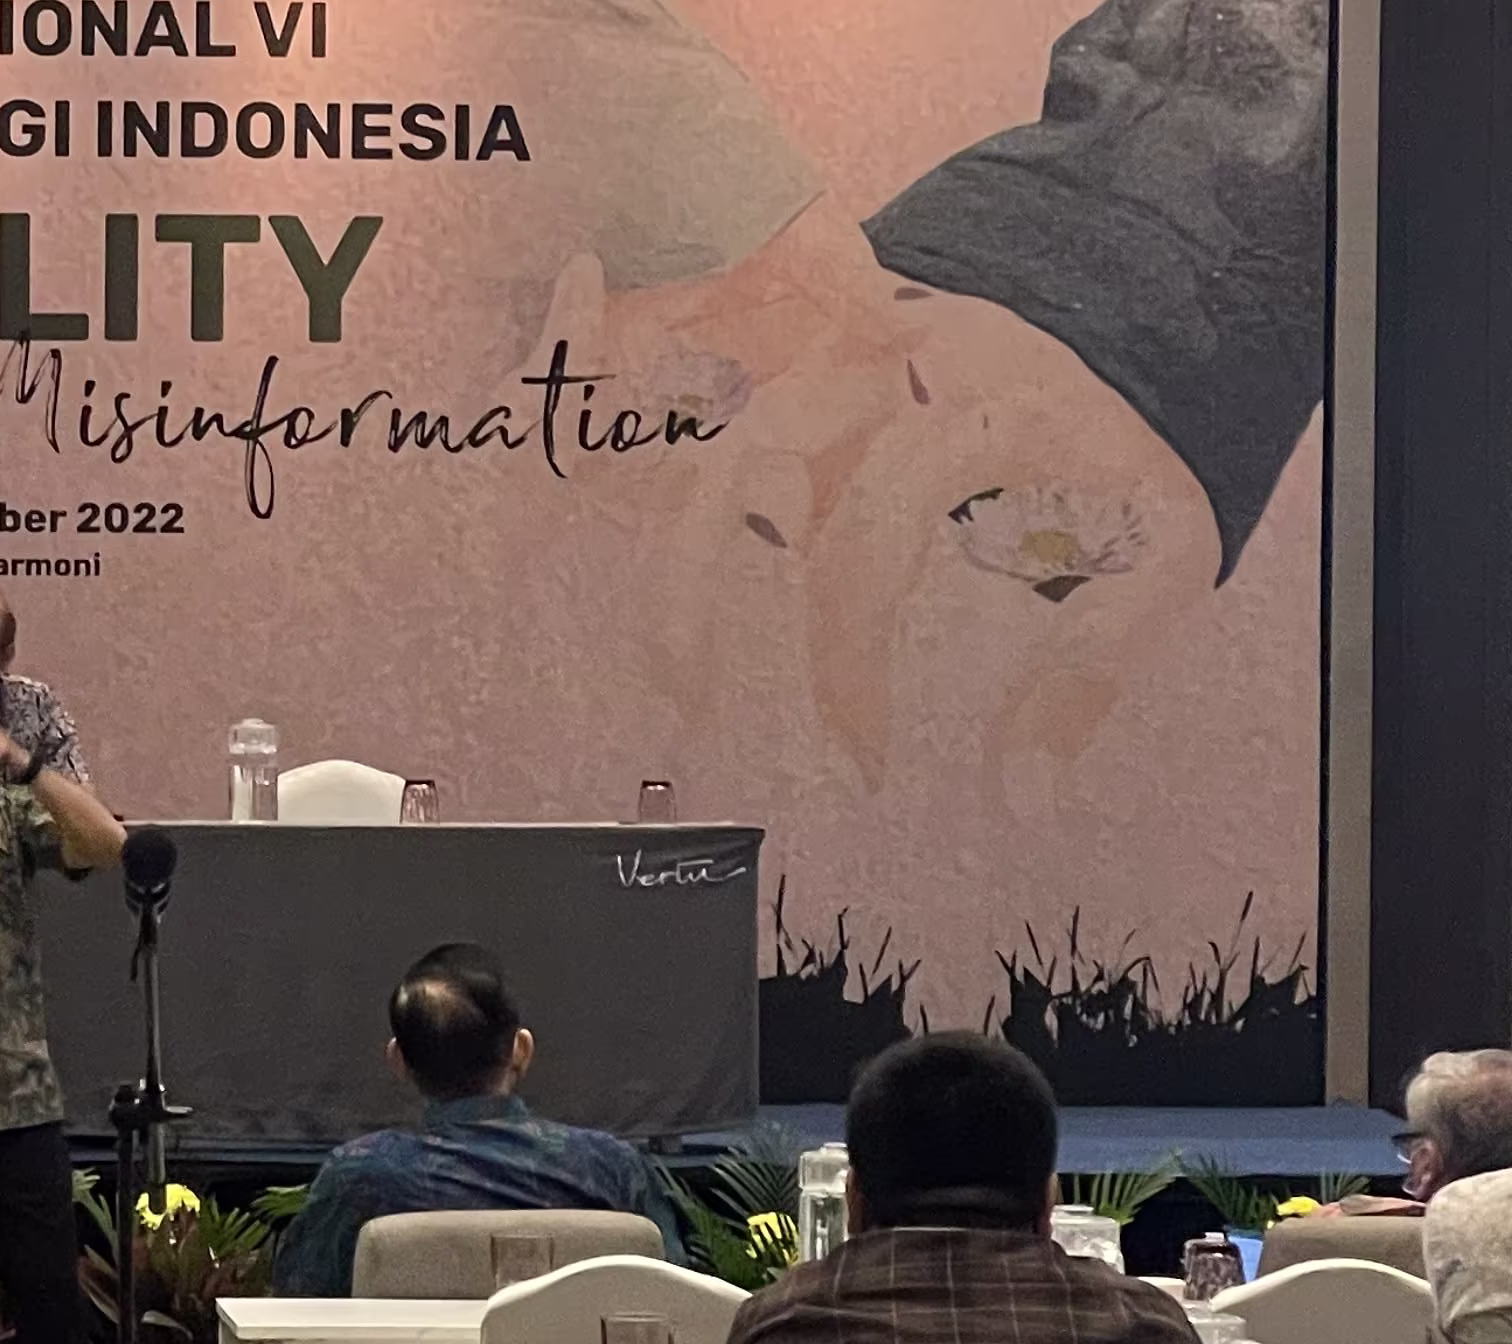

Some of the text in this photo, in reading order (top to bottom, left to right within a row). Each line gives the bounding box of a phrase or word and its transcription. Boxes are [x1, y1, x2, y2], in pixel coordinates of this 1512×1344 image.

[253, 1, 326, 58] VI
[97, 100, 531, 162] INDONESIA
[76, 502, 185, 534] 2022
[616, 848, 747, 887] Vertu
